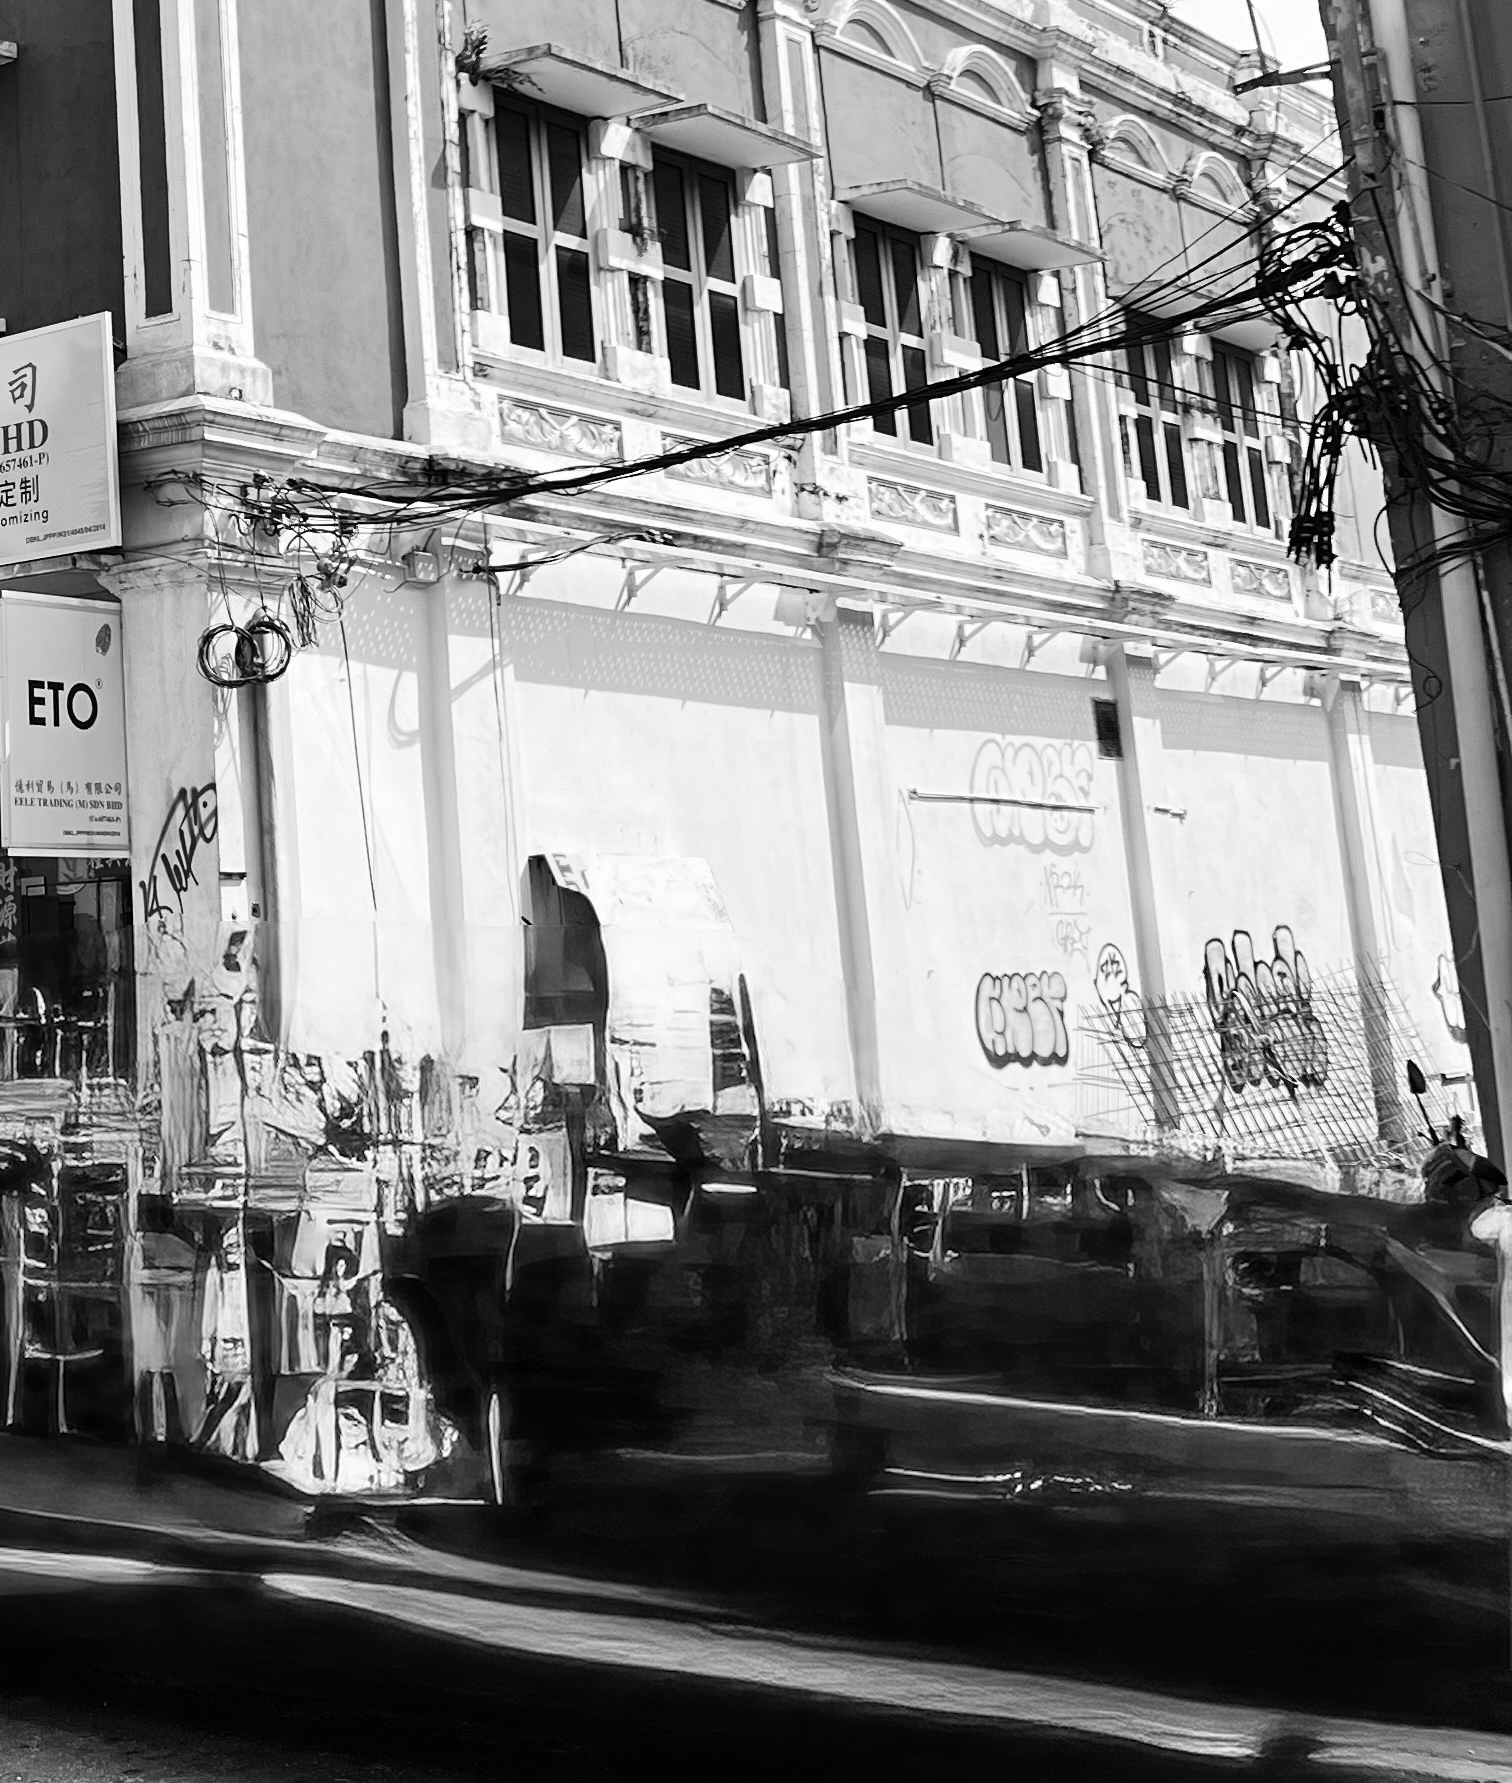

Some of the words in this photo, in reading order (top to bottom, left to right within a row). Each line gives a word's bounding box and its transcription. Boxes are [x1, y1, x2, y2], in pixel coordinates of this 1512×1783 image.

[28, 680, 98, 730] ETO
[14, 796, 35, 807] EELE
[36, 797, 74, 808] TRADING
[75, 799, 88, 810] (M)
[89, 799, 105, 810] SDN
[106, 800, 123, 810] BHD
